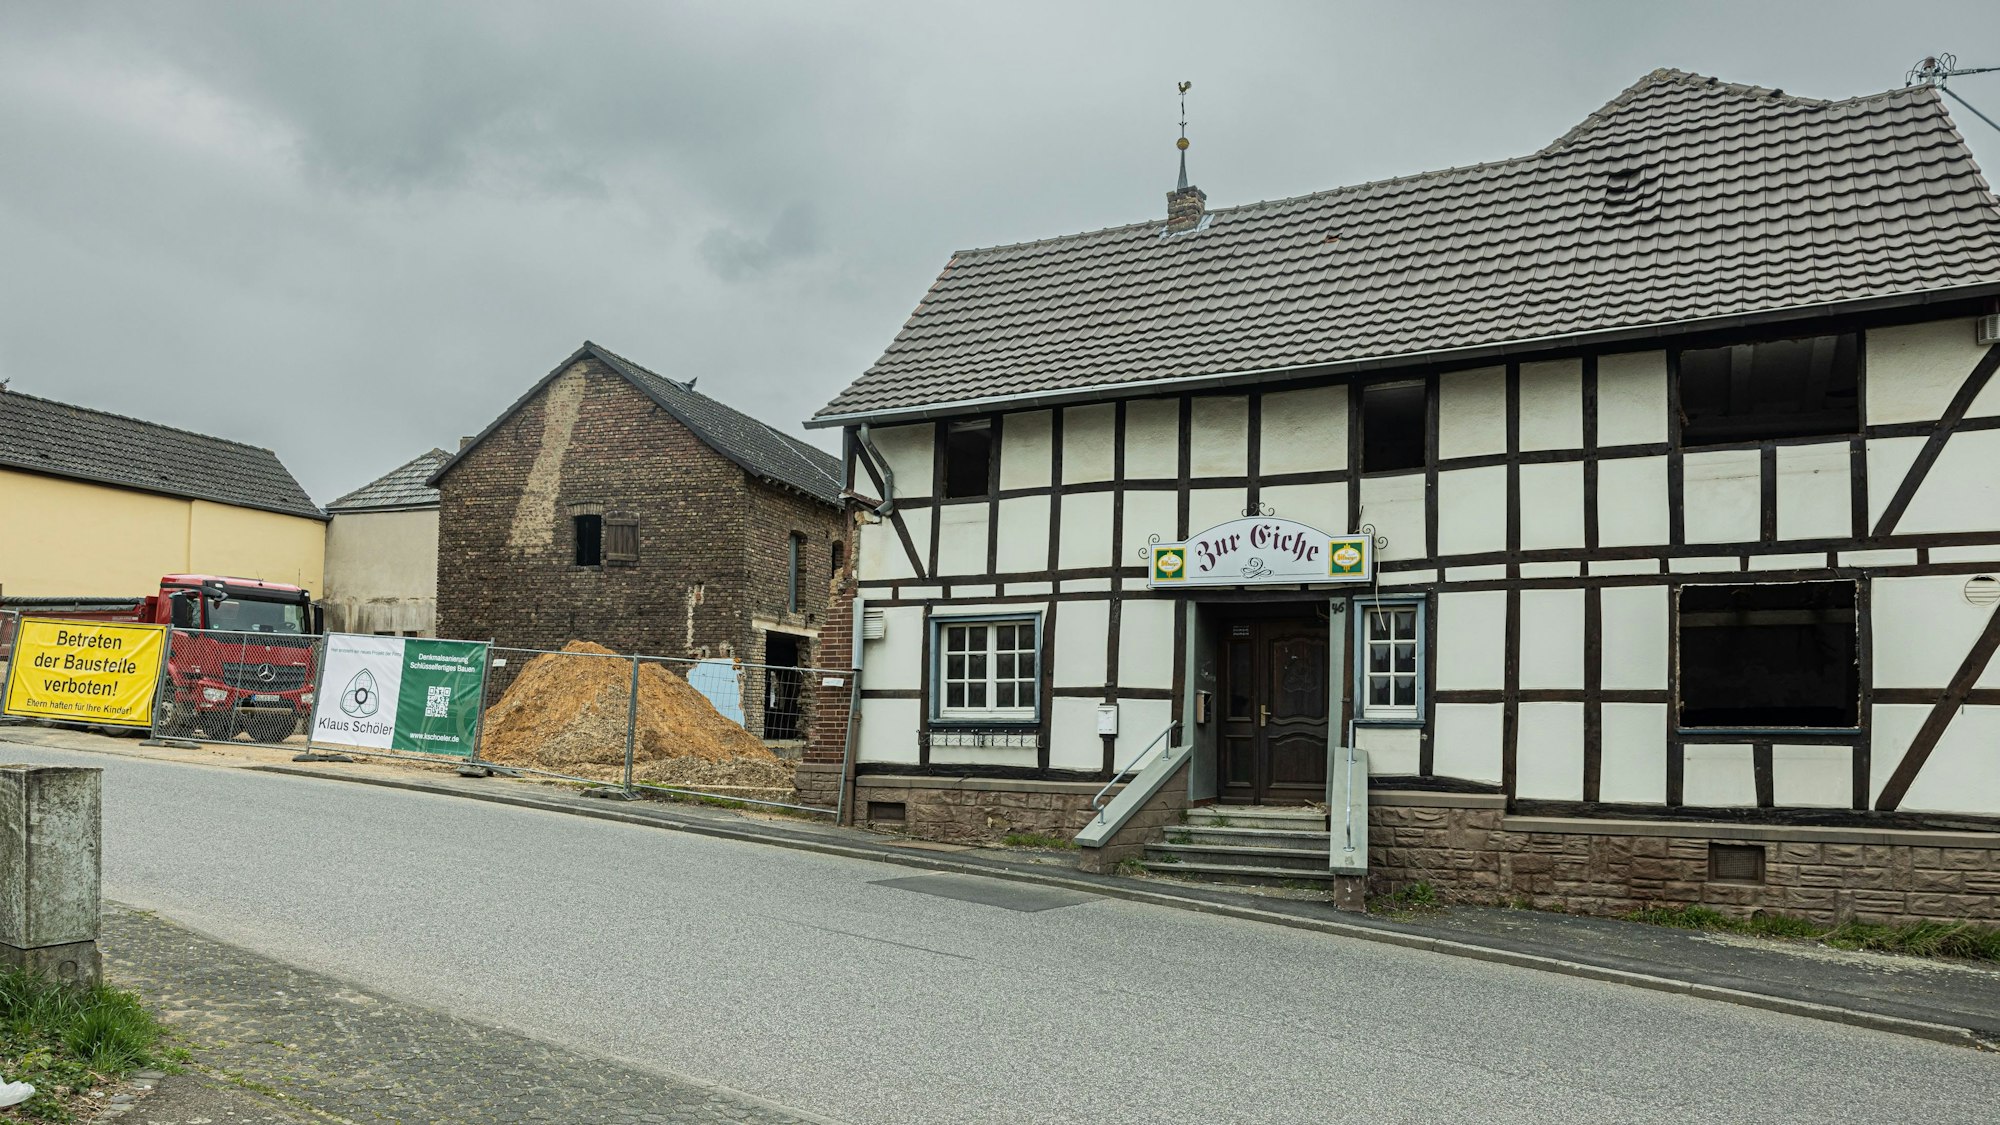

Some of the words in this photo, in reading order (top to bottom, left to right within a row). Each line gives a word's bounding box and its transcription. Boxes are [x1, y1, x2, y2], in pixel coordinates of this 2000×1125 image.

[1195, 534, 1241, 572] Zur
[1250, 524, 1319, 562] Eiche
[1332, 601, 1345, 614] 46
[56, 630, 122, 650] Betreten
[34, 652, 60, 668] der
[418, 653, 469, 664] Denkmalsanierung
[409, 662, 456, 672] Schlüsselfertiges
[457, 665, 476, 673] Bauen
[44, 677, 118, 697] verboten!
[26, 698, 47, 708] Eltern
[50, 700, 73, 710] haften
[75, 702, 84, 711] für
[86, 703, 101, 713] Ihre
[103, 704, 132, 715] Kinder!
[318, 717, 349, 731] Klaus
[352, 721, 393, 735] Schöler
[409, 732, 460, 743] www.kschoeler.de
